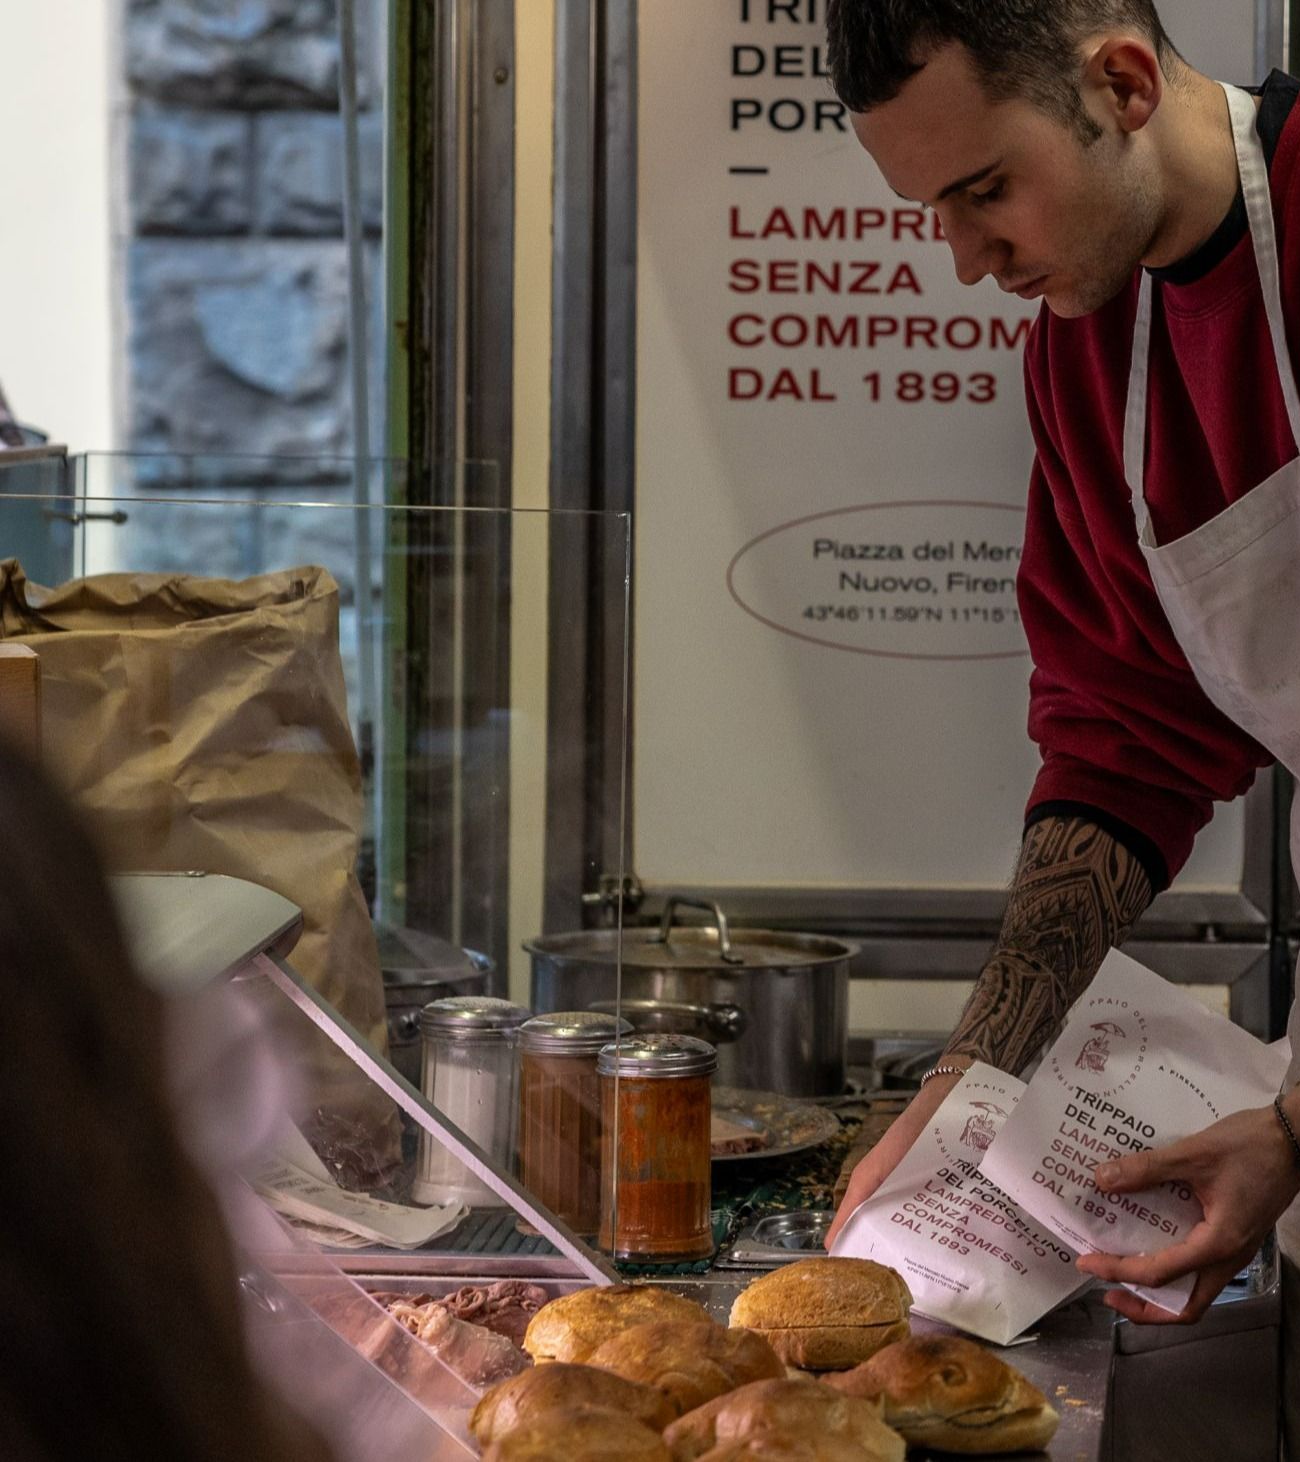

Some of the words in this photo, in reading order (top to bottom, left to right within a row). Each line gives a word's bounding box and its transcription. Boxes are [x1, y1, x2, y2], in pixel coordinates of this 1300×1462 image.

[740, 0, 817, 23] TRI
[732, 45, 831, 77] DEL
[731, 99, 848, 132] POR
[729, 259, 924, 295] SENZA
[728, 313, 1033, 350] COMPROM
[729, 367, 837, 401] DAL
[863, 372, 997, 402] 1893
[813, 538, 904, 560] Piazza
[912, 541, 954, 562] del
[839, 570, 939, 597] Nuovo,
[946, 570, 1016, 594] Firen
[1158, 1064, 1165, 1072] A
[1170, 1069, 1205, 1099] FIRENZE
[1064, 1103, 1097, 1131] DEL
[1074, 1086, 1156, 1139] TRIPPAIO
[1050, 1138, 1101, 1173] SENZ
[913, 1192, 970, 1226] SENZA
[1031, 1170, 1066, 1199] DAL
[1074, 1194, 1118, 1225] 1893
[924, 1179, 1047, 1258] LAMPREDOTTO
[936, 1167, 965, 1191] DEL
[969, 1186, 1072, 1264] PORCELLINO
[890, 1212, 922, 1235] DAL
[930, 1231, 971, 1257] 1893
[903, 1202, 1029, 1276] COMPROMESSI
